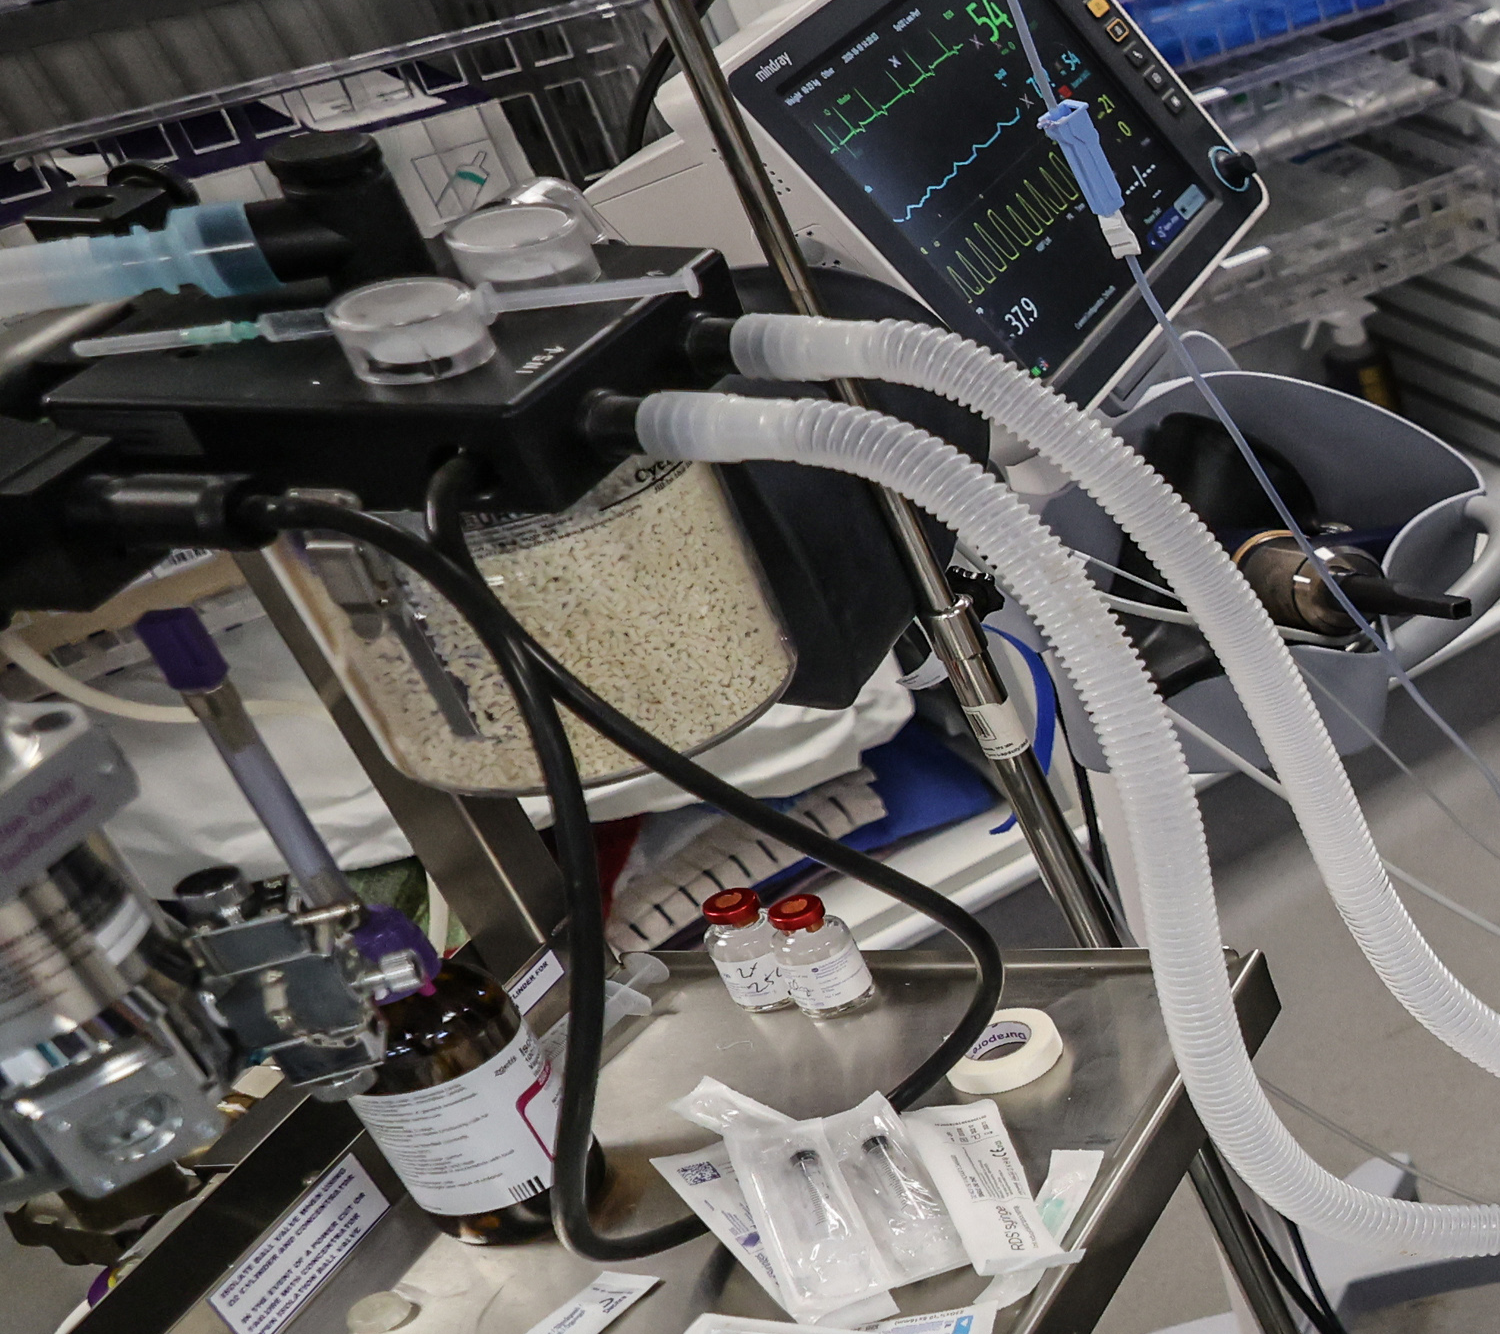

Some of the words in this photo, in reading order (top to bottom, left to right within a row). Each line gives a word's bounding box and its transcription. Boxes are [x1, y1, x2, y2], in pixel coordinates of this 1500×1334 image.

[755, 51, 792, 83] mindray
[1061, 50, 1081, 71] 54
[1004, 296, 1039, 337] 37.9
[511, 975, 536, 999] LINDER
[535, 960, 549, 976] FOR
[971, 1030, 1027, 1056] Durapore
